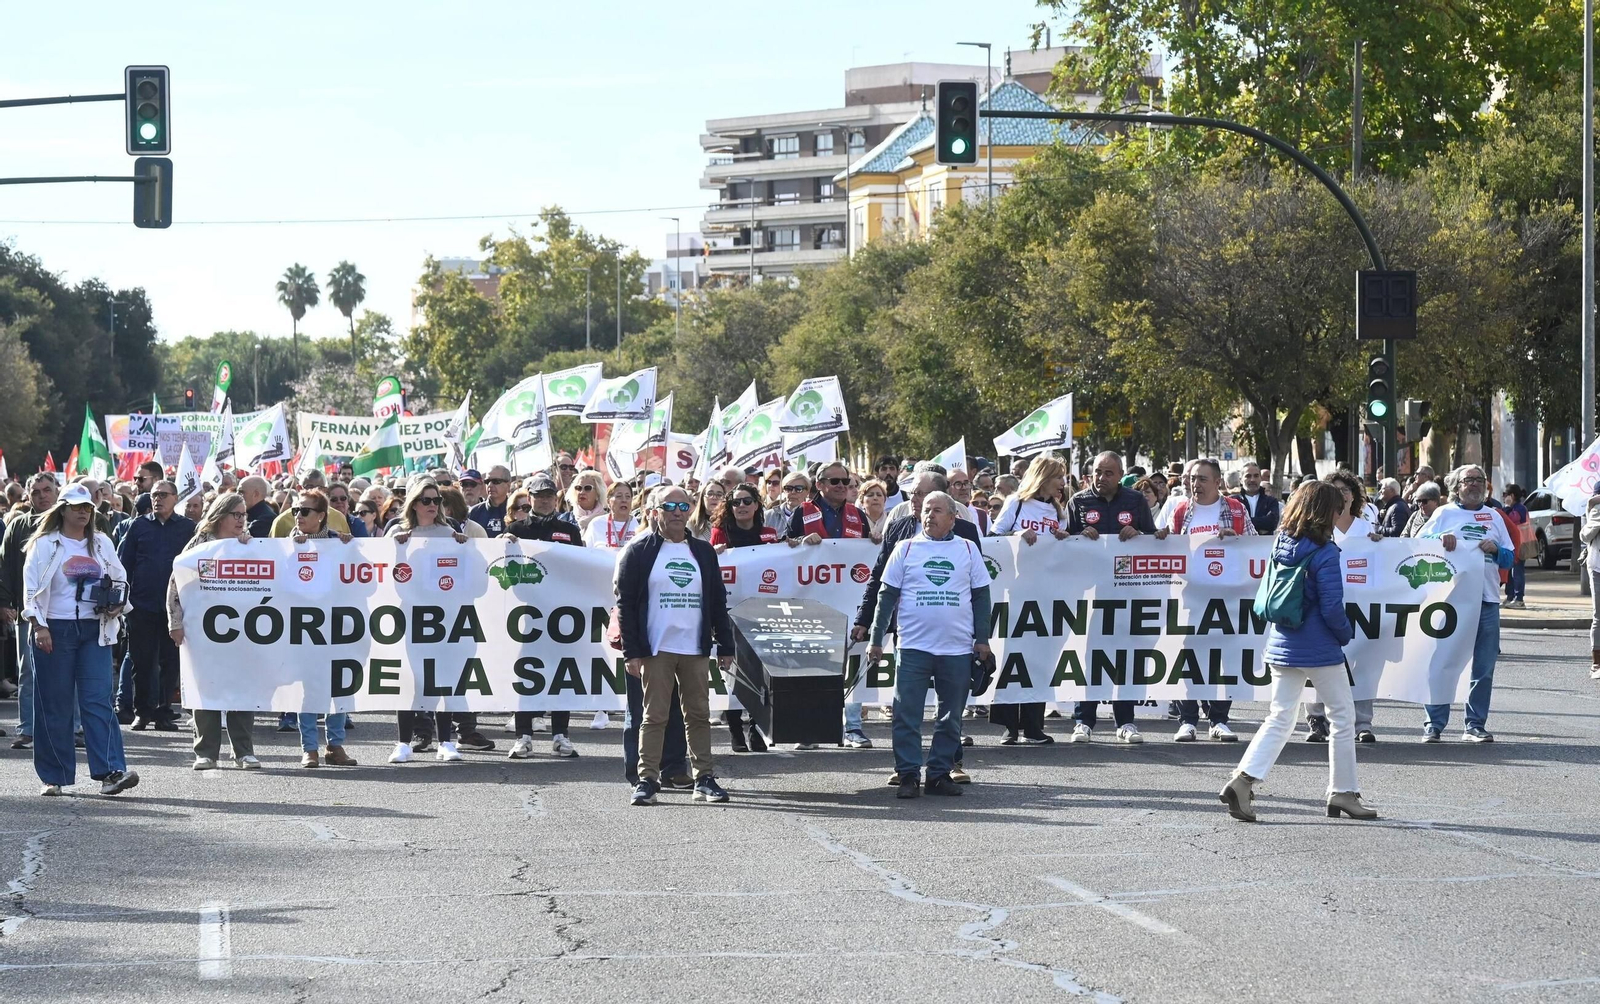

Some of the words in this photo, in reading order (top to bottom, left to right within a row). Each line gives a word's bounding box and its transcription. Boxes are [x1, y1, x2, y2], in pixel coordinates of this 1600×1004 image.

[312, 420, 370, 436] FERNÁN
[1021, 519, 1045, 532] UGT
[1190, 525, 1212, 534] SANIDAD
[220, 562, 272, 577] CCOO
[340, 563, 388, 583] UGT
[1135, 558, 1184, 572] CCOO
[798, 564, 846, 585] UGT
[203, 597, 486, 644] CÓRDOBA
[331, 659, 401, 697] DE
[423, 658, 492, 696] LA
